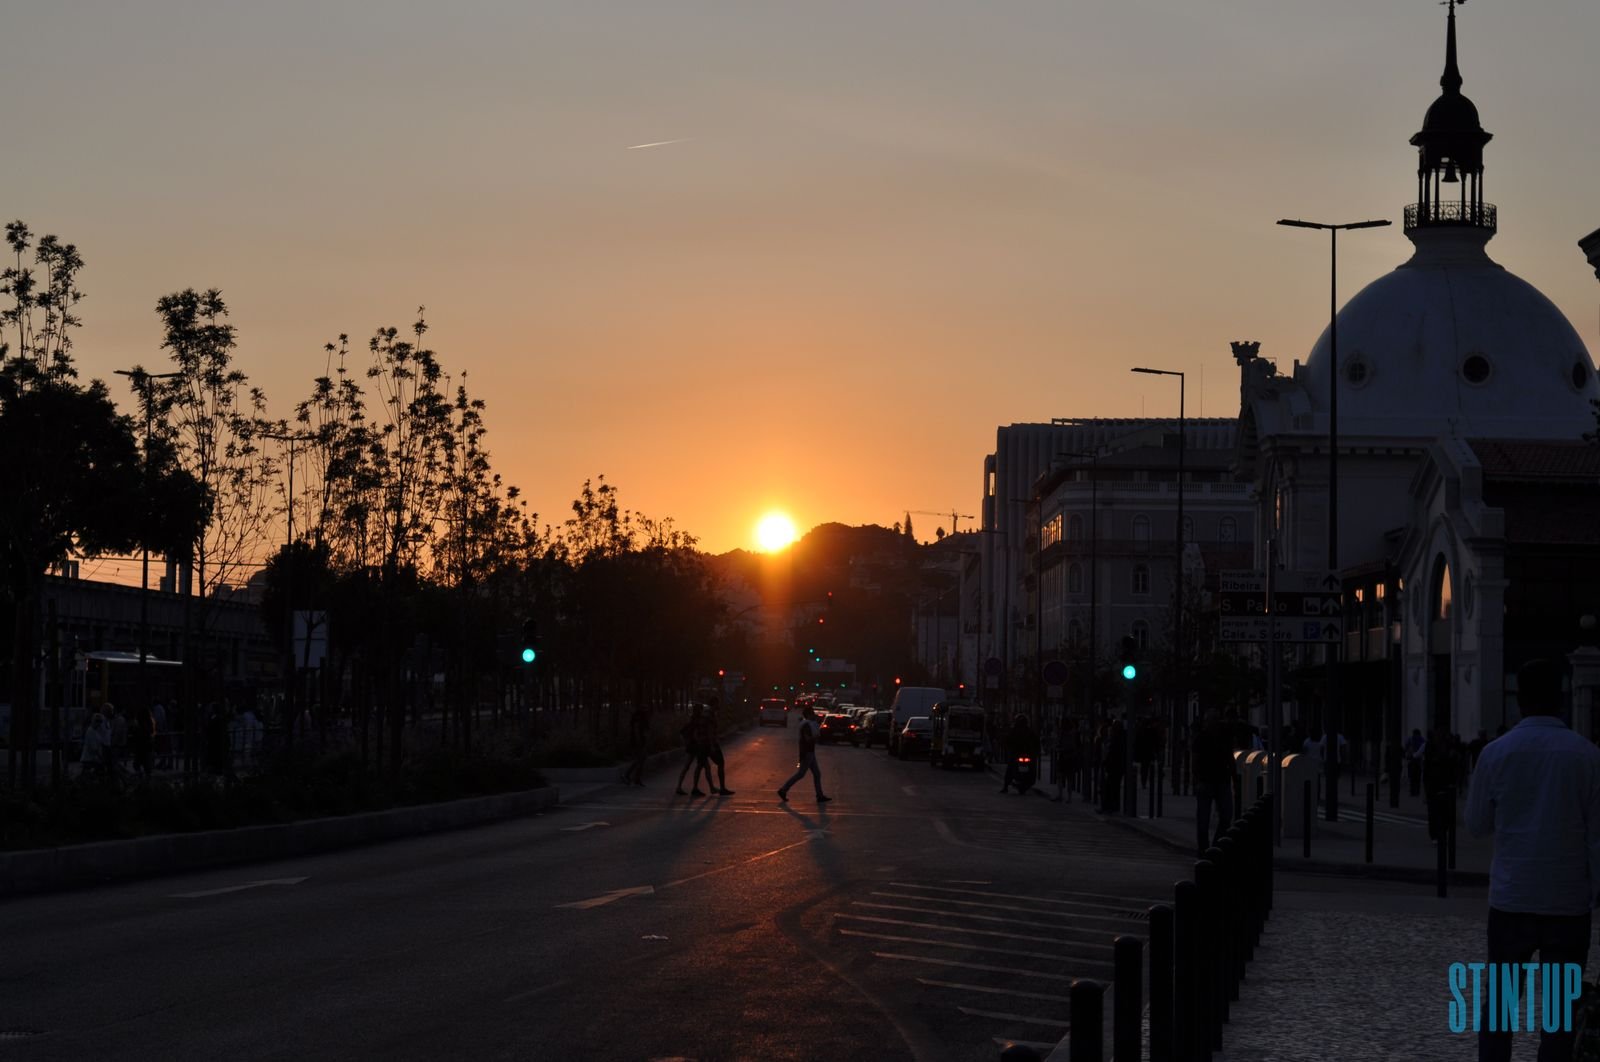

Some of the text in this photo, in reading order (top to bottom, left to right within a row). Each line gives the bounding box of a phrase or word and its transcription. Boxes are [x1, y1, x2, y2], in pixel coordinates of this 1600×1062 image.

[1222, 581, 1261, 590] Ribeira
[1222, 598, 1288, 612] S. Palo
[1222, 629, 1246, 639] Cais
